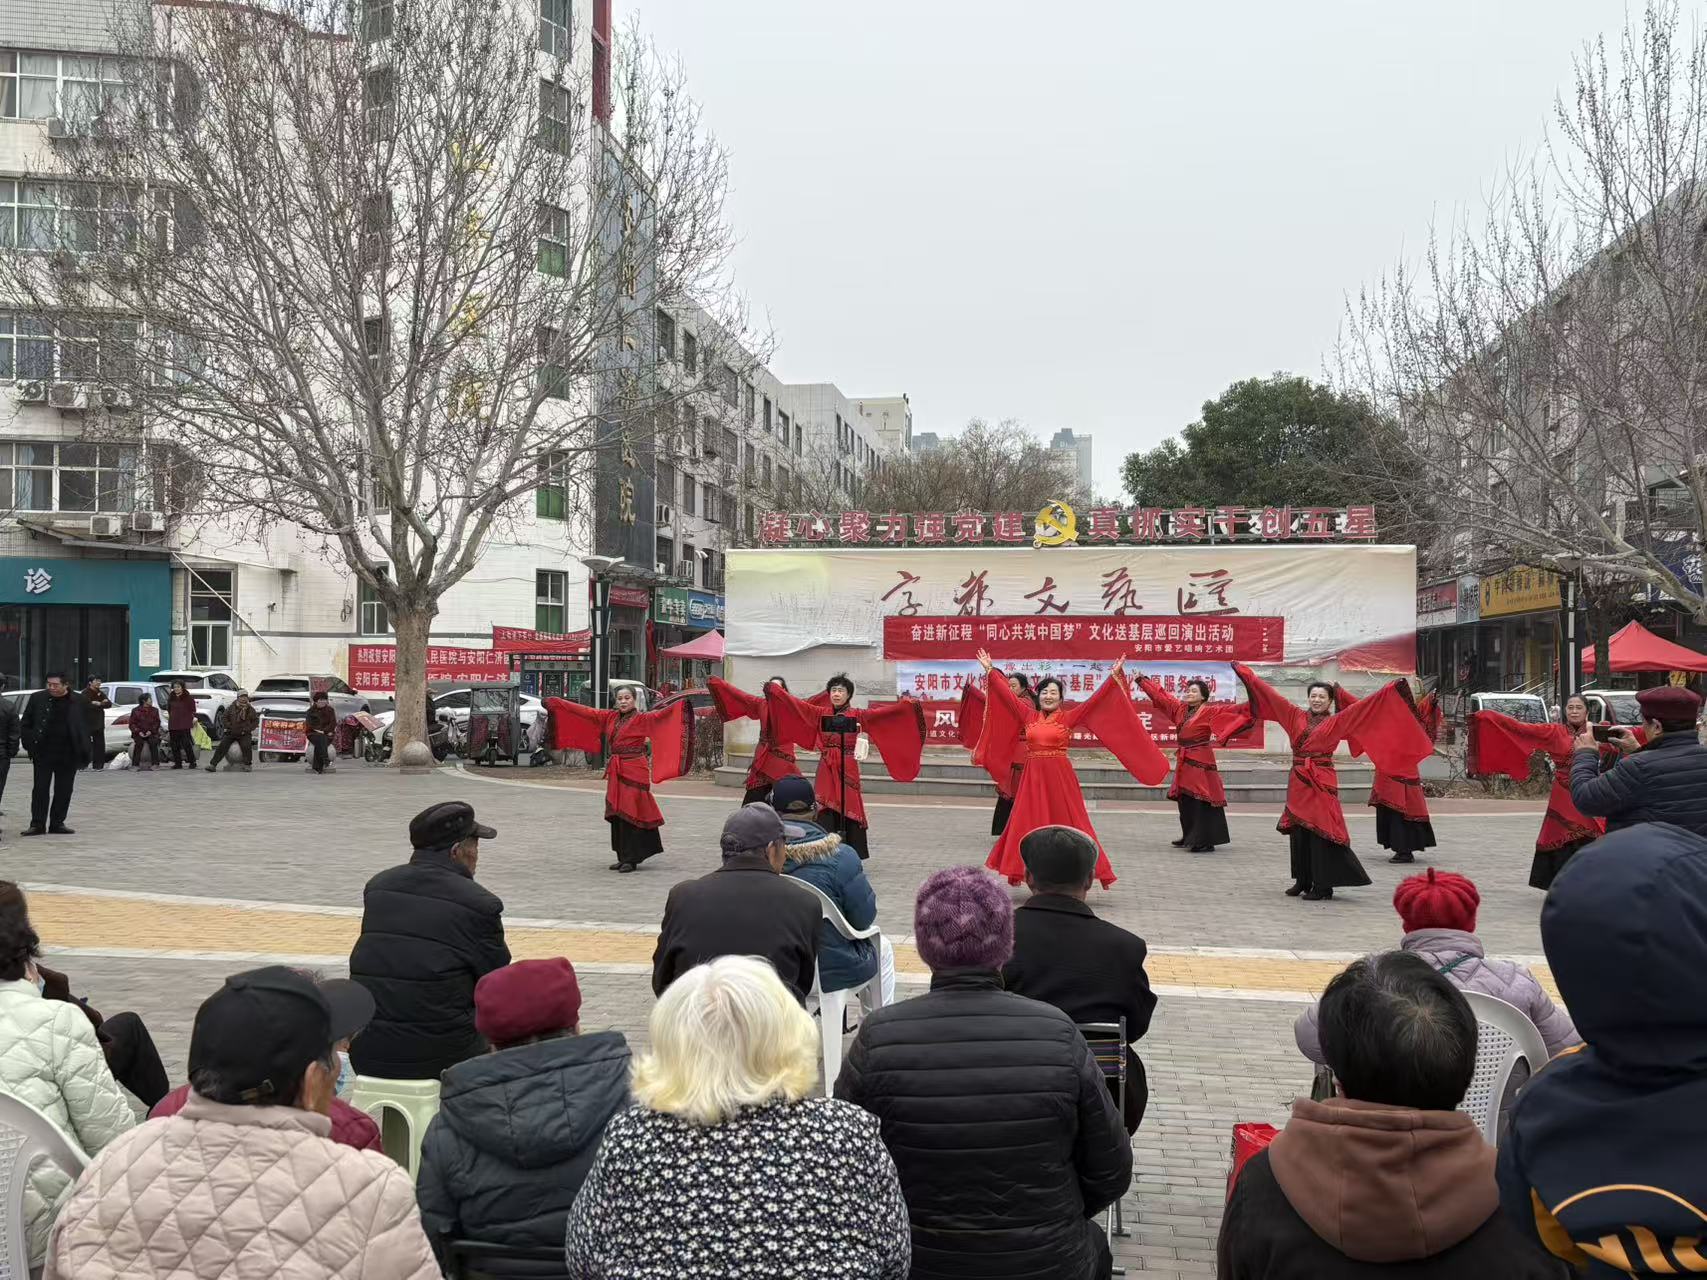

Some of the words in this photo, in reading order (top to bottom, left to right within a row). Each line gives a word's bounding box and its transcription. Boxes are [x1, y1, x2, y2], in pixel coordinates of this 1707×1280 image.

[756, 509, 1025, 544] 凝心聚力强党建
[1087, 504, 1377, 540] 真抓实干创五星
[24, 567, 53, 595] 诊
